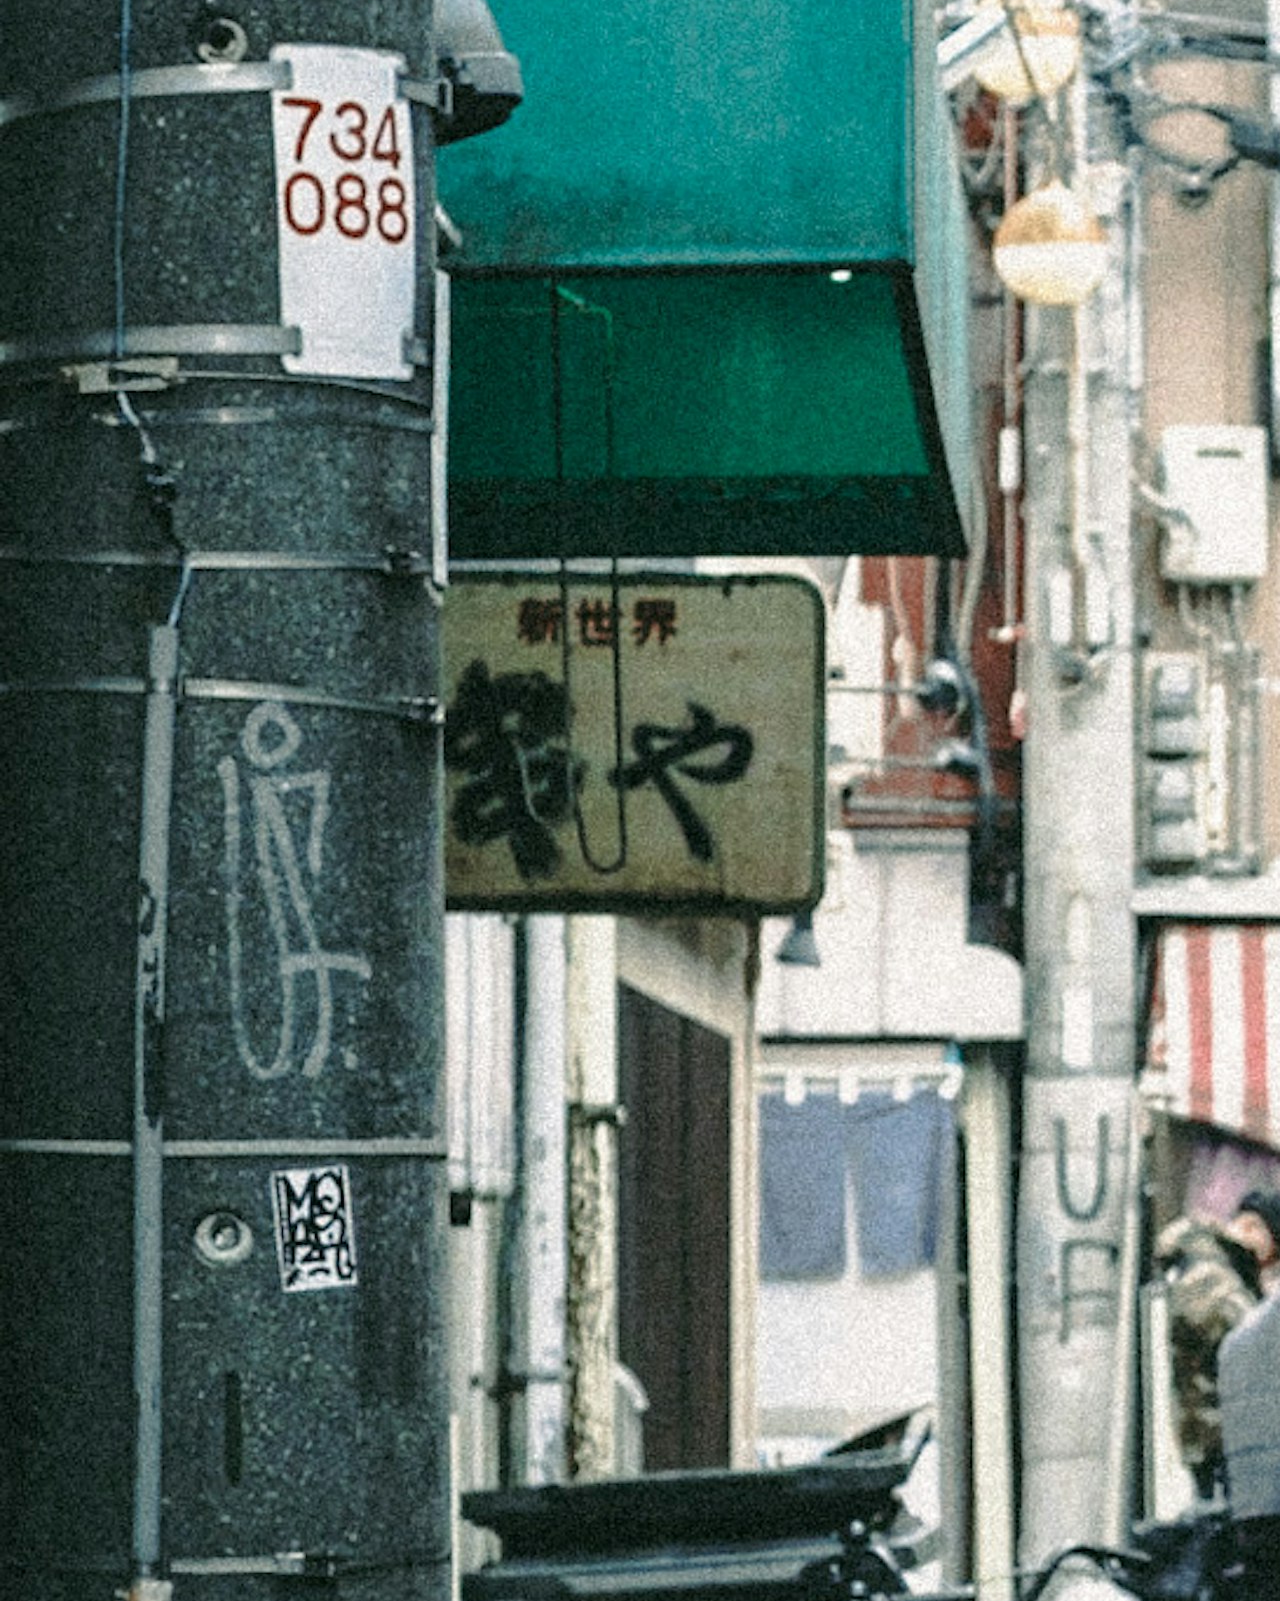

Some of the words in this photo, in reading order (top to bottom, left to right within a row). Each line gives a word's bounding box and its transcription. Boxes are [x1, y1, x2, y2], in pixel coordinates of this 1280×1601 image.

[281, 97, 402, 169] 734
[284, 172, 408, 245] 088
[517, 598, 678, 648] 新世界
